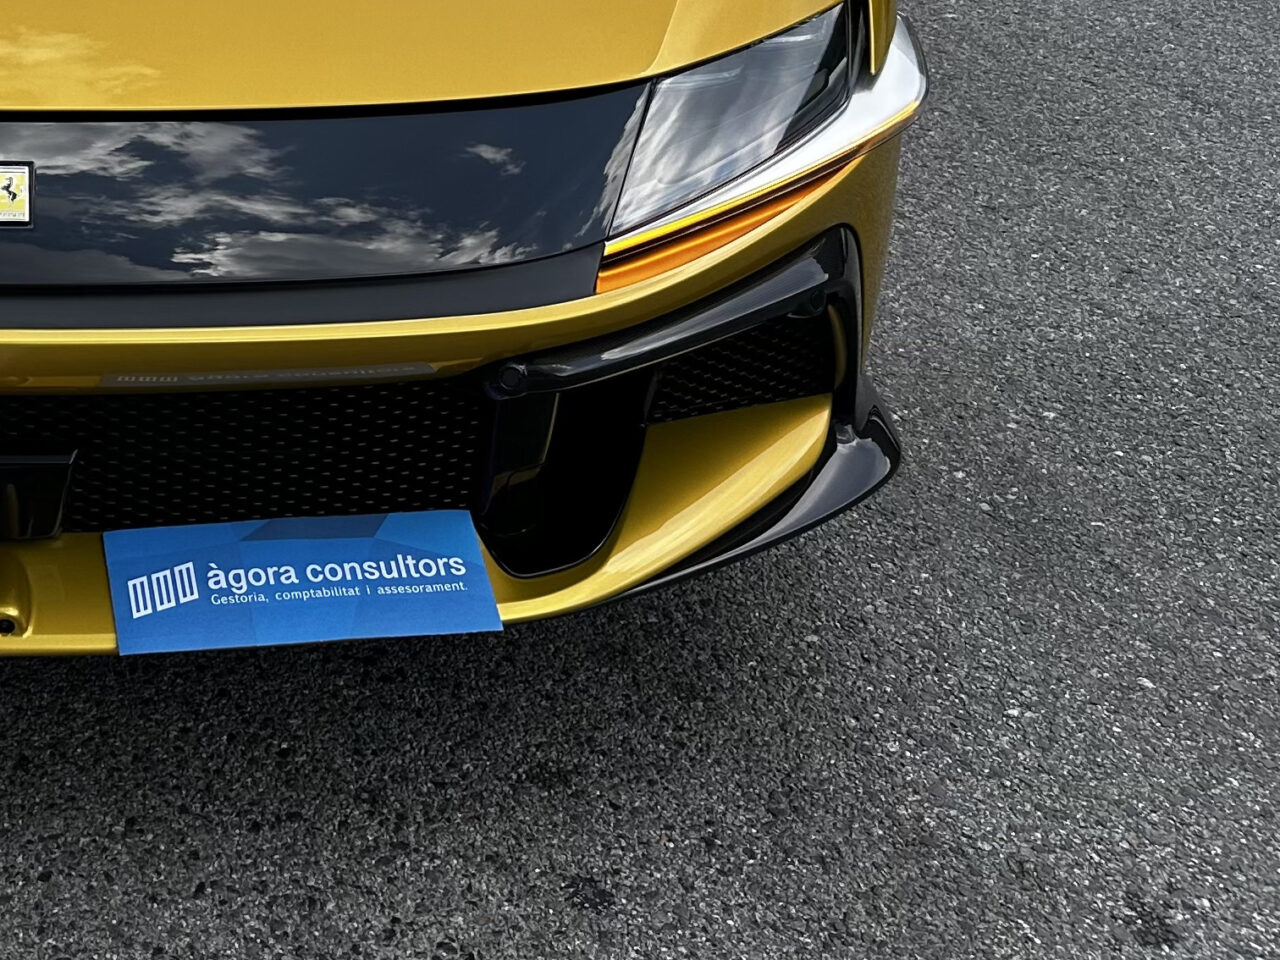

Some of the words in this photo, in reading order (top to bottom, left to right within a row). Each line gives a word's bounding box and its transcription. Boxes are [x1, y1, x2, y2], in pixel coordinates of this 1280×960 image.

[206, 562, 300, 594] àgora
[305, 553, 467, 583] consultors
[210, 592, 269, 605] Gestoria,
[275, 586, 361, 601] comptabilitat
[365, 584, 371, 595] i
[376, 581, 468, 595] assesorament.
